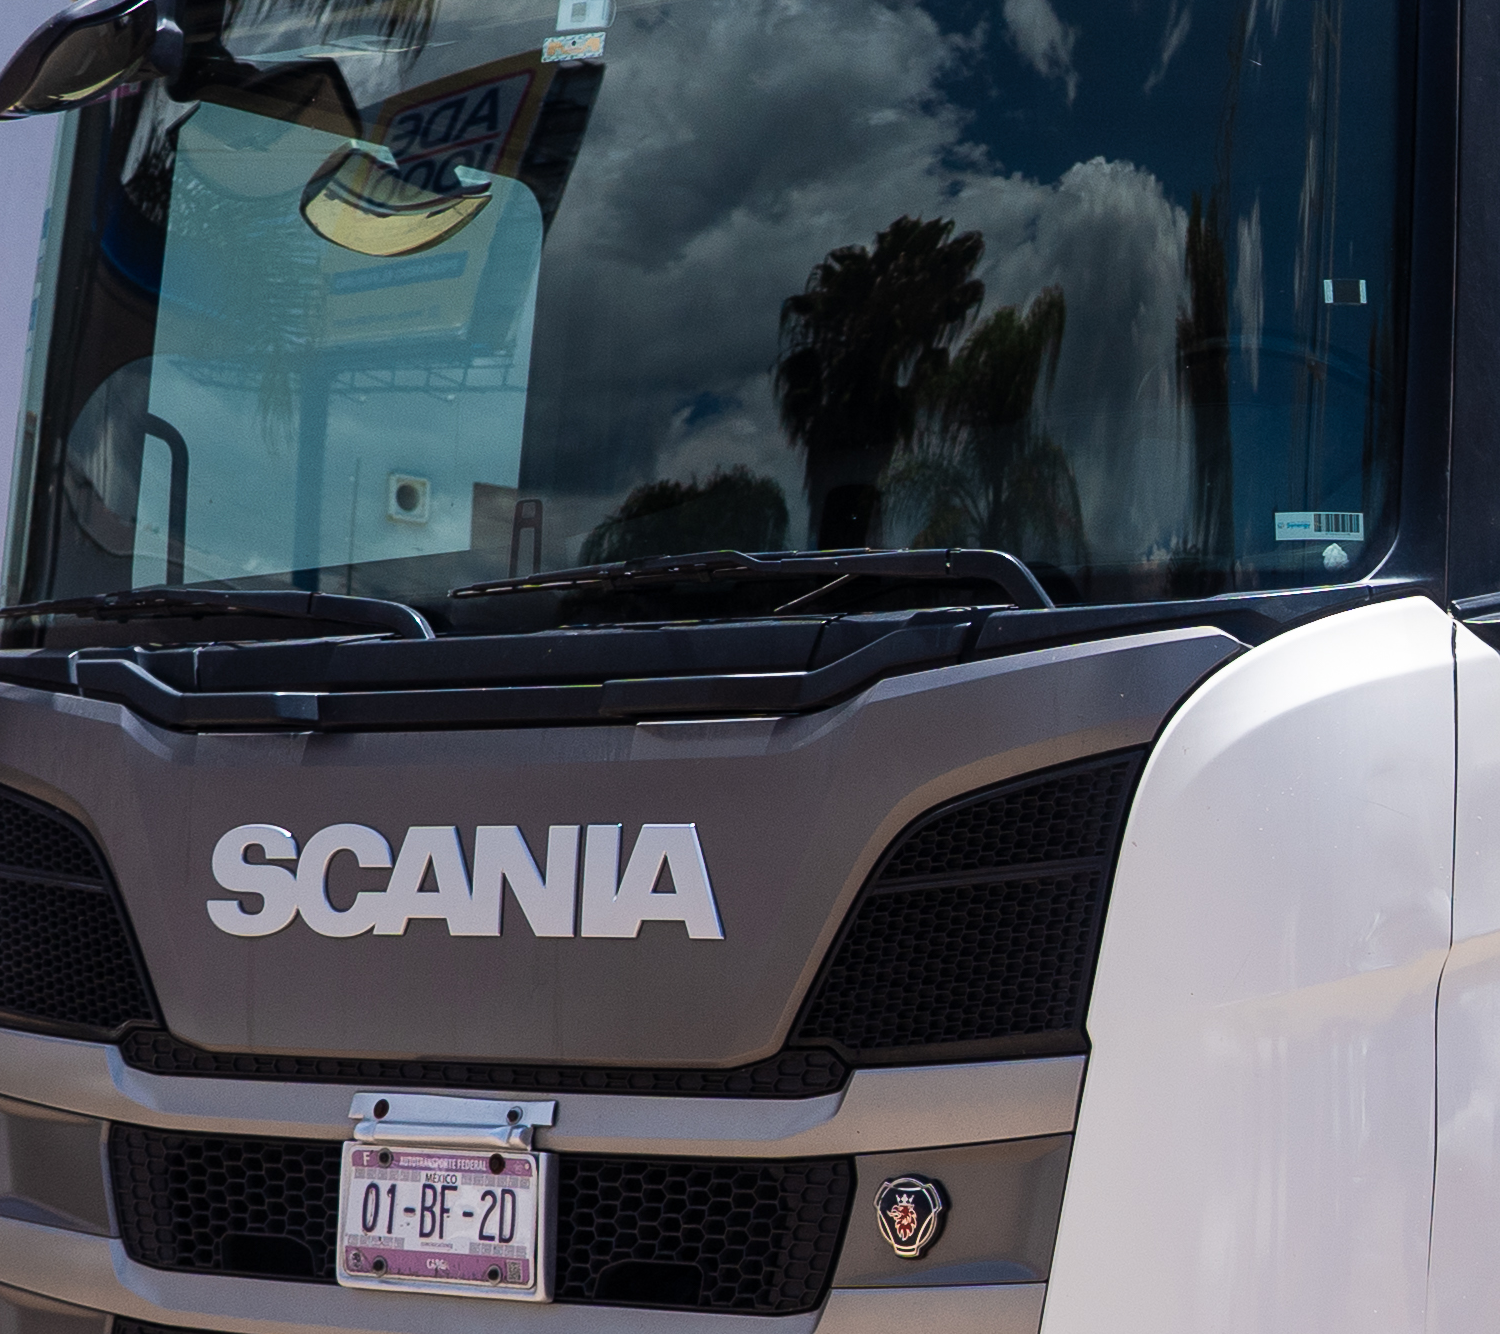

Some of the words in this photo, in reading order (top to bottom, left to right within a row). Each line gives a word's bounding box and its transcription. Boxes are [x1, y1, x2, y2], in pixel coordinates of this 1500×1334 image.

[206, 823, 725, 940] SCANIA
[399, 1156, 457, 1169] AUTOTRANSPORTE
[457, 1159, 487, 1171] FEDERAL
[425, 1172, 457, 1184] MÉXICO
[362, 1182, 516, 1243] 01-BF-2D
